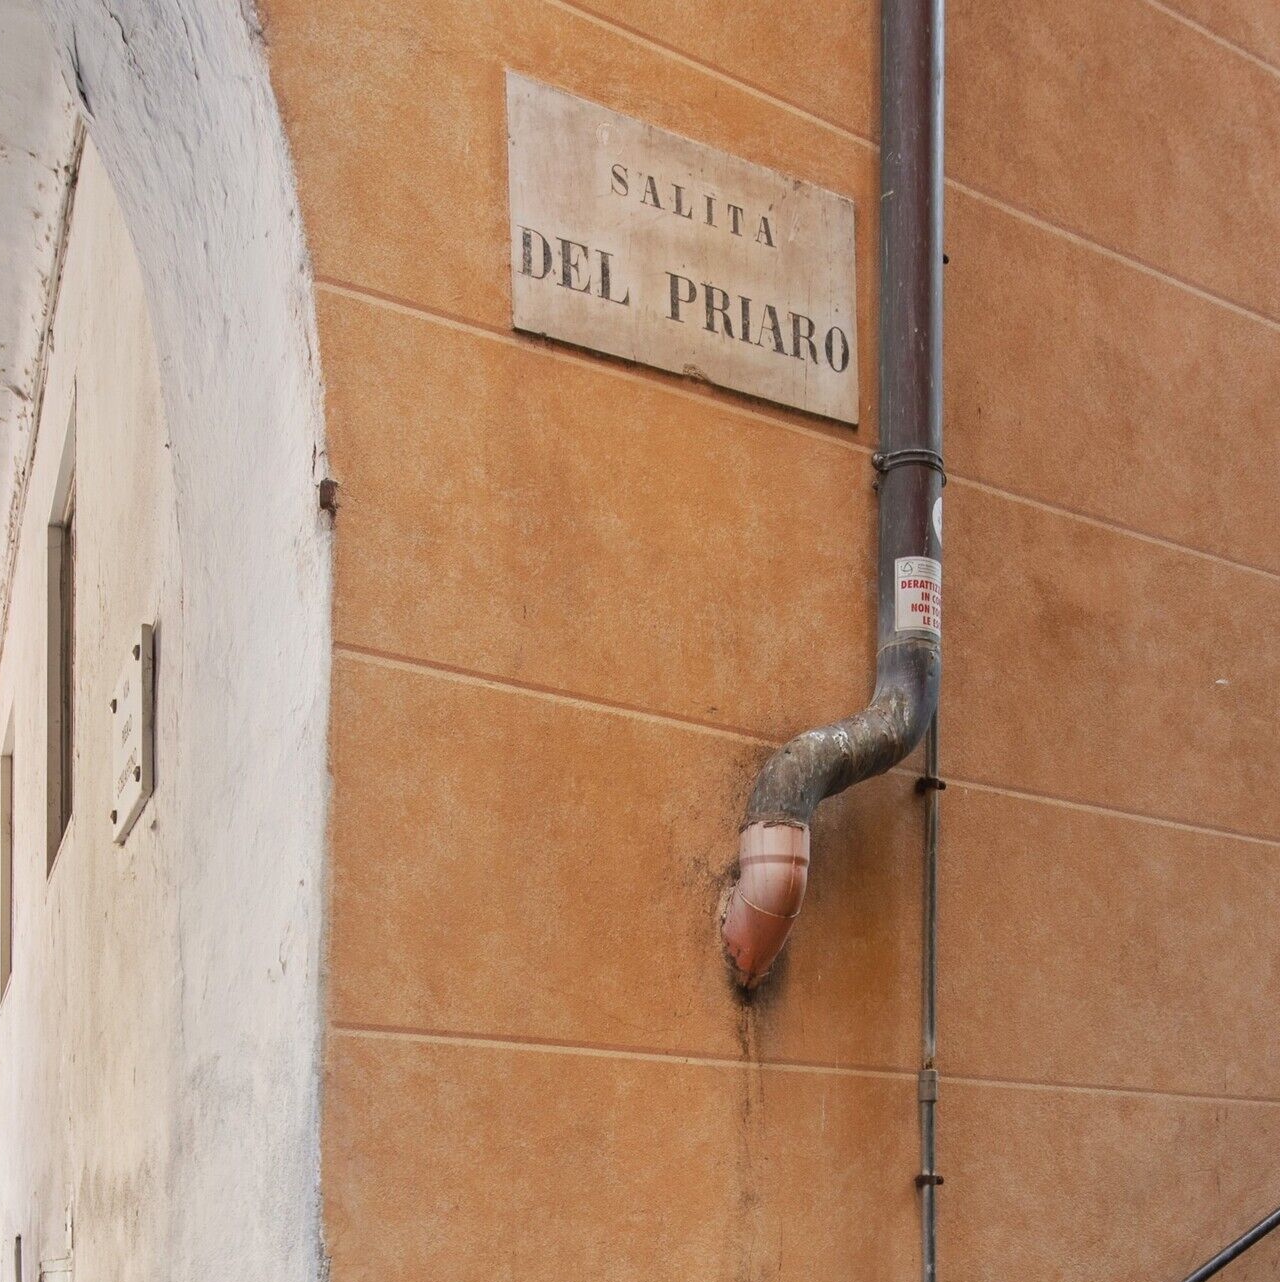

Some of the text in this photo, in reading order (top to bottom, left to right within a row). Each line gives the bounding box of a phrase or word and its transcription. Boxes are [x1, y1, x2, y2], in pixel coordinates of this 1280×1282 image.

[517, 224, 851, 373] DEL PRIARO
[922, 592, 930, 601] IN
[911, 603, 930, 613] NON
[923, 616, 931, 625] LE
